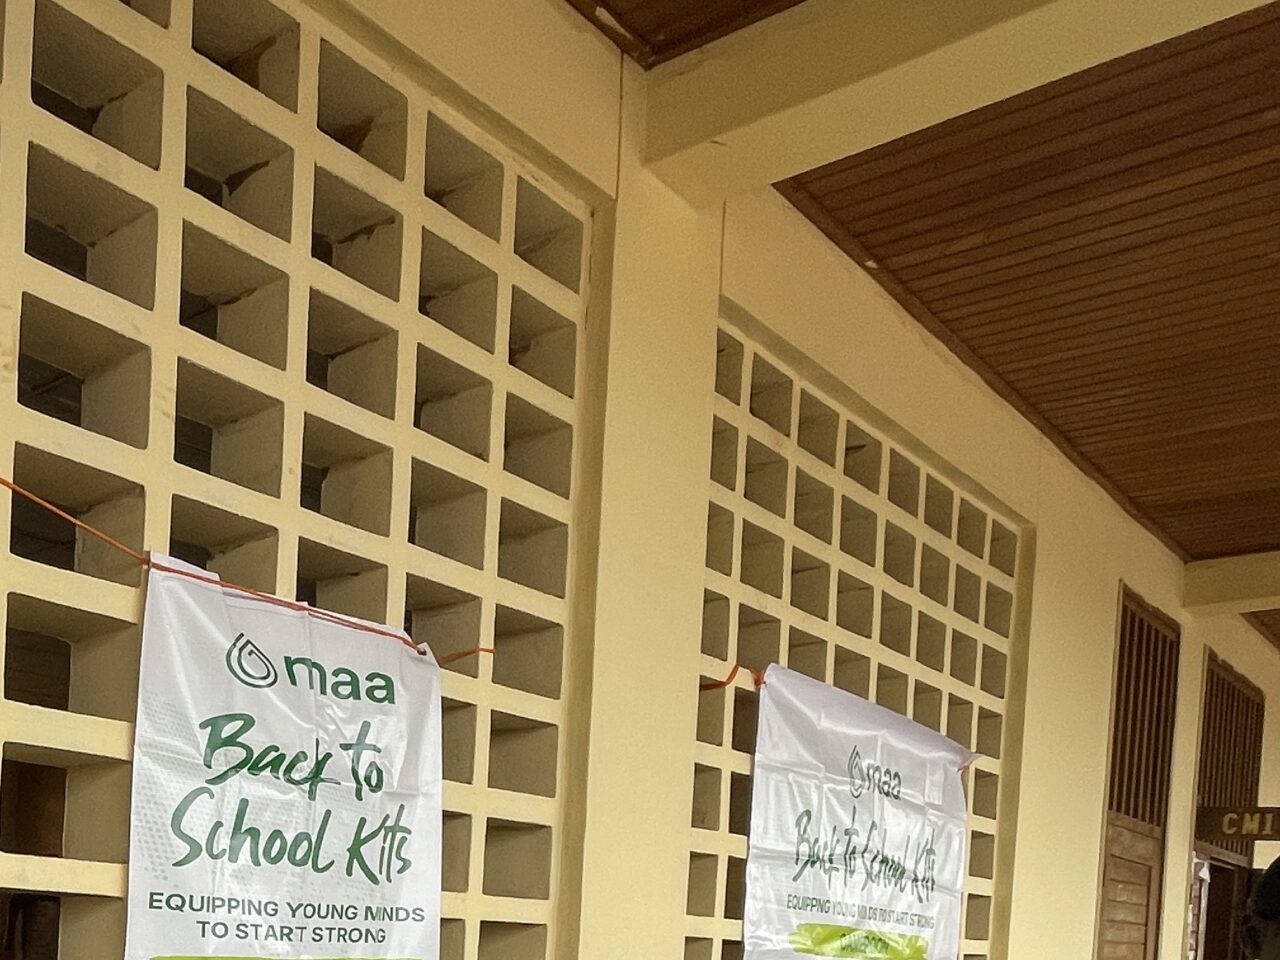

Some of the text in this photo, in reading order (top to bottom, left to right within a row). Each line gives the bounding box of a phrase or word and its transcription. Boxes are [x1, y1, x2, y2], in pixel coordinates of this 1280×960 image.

[284, 653, 396, 705] maa
[198, 713, 385, 801] Back to
[170, 786, 413, 886] School Kits
[148, 891, 278, 918] EQUIPPING
[286, 901, 358, 921] YOUNG
[196, 920, 386, 944] TO START STRONG
